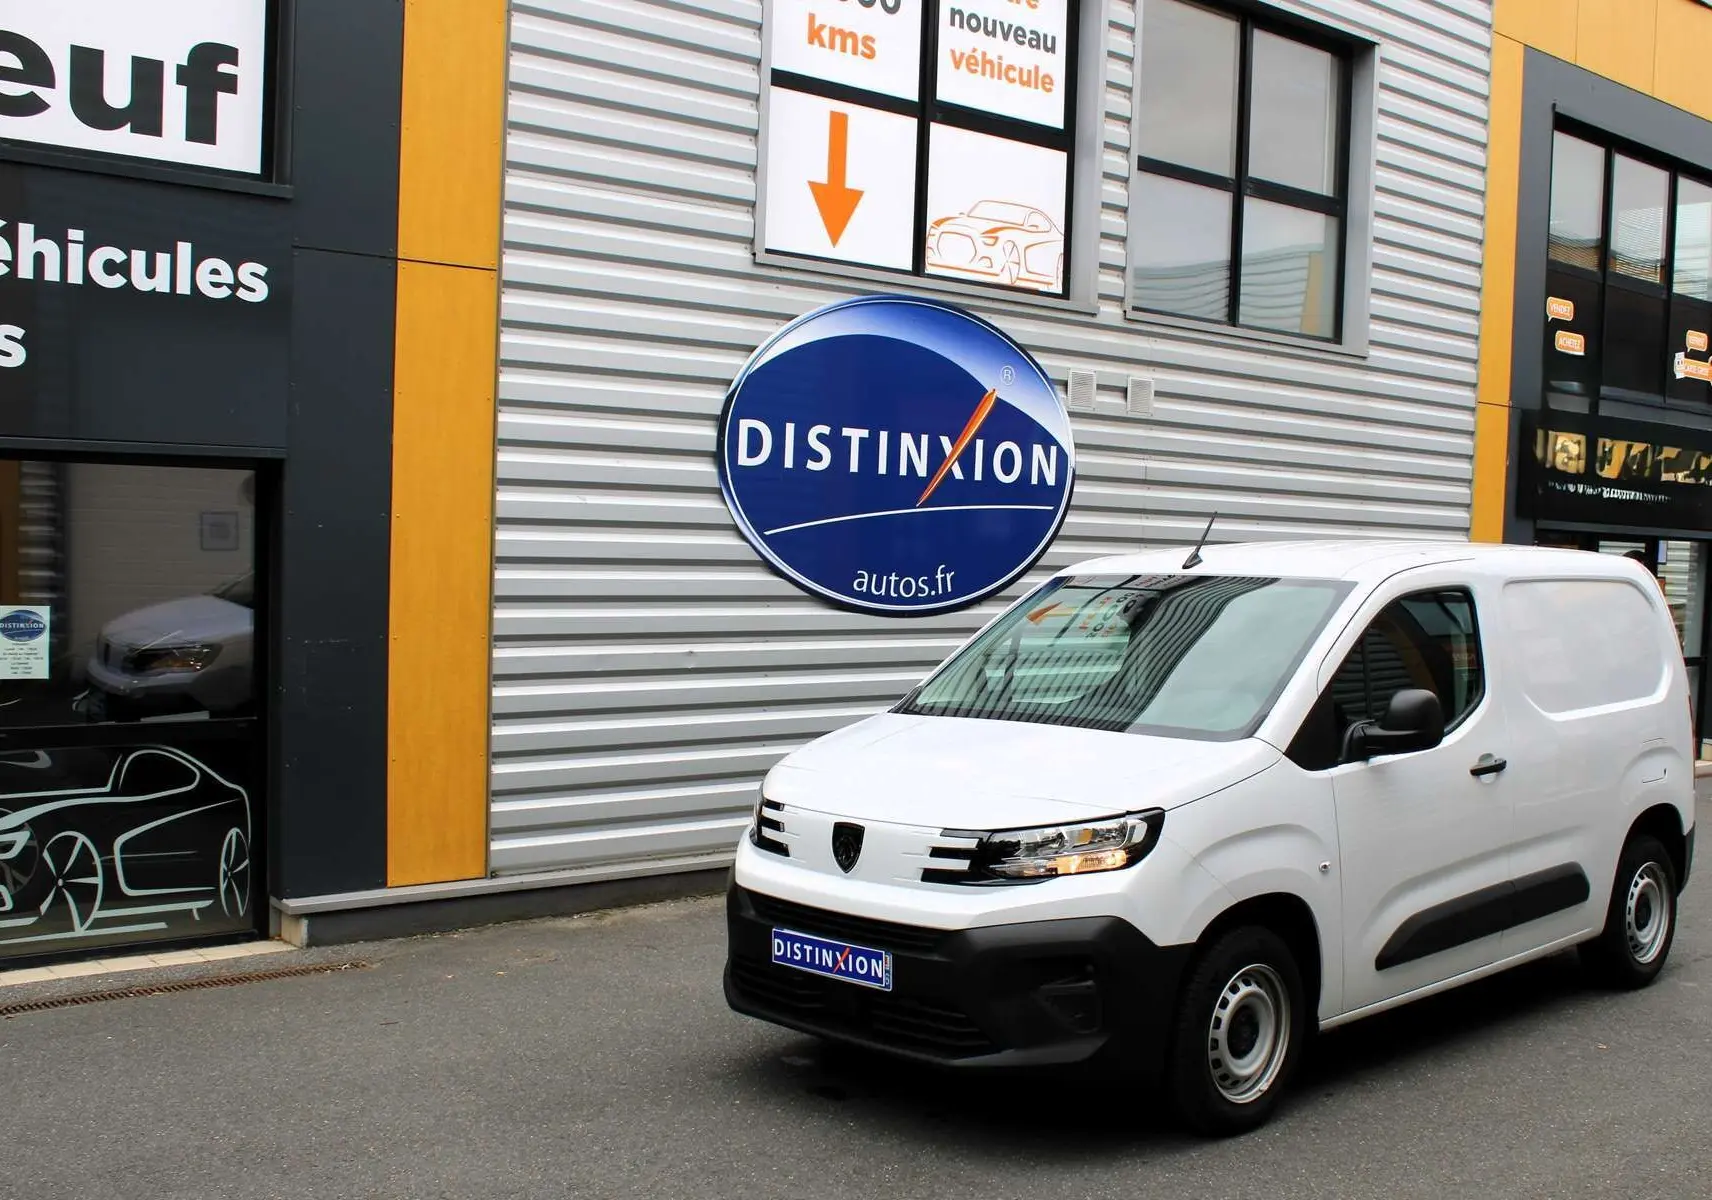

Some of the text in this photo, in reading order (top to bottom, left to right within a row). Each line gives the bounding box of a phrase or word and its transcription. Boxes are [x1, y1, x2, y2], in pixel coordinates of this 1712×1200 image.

[807, 12, 877, 60] kms
[949, 6, 1057, 55] nouveau
[950, 47, 1055, 93] véhicule
[737, 417, 1058, 488] DISTINXION
[852, 564, 955, 599] autos.fr
[774, 938, 883, 978] DISTINXION
